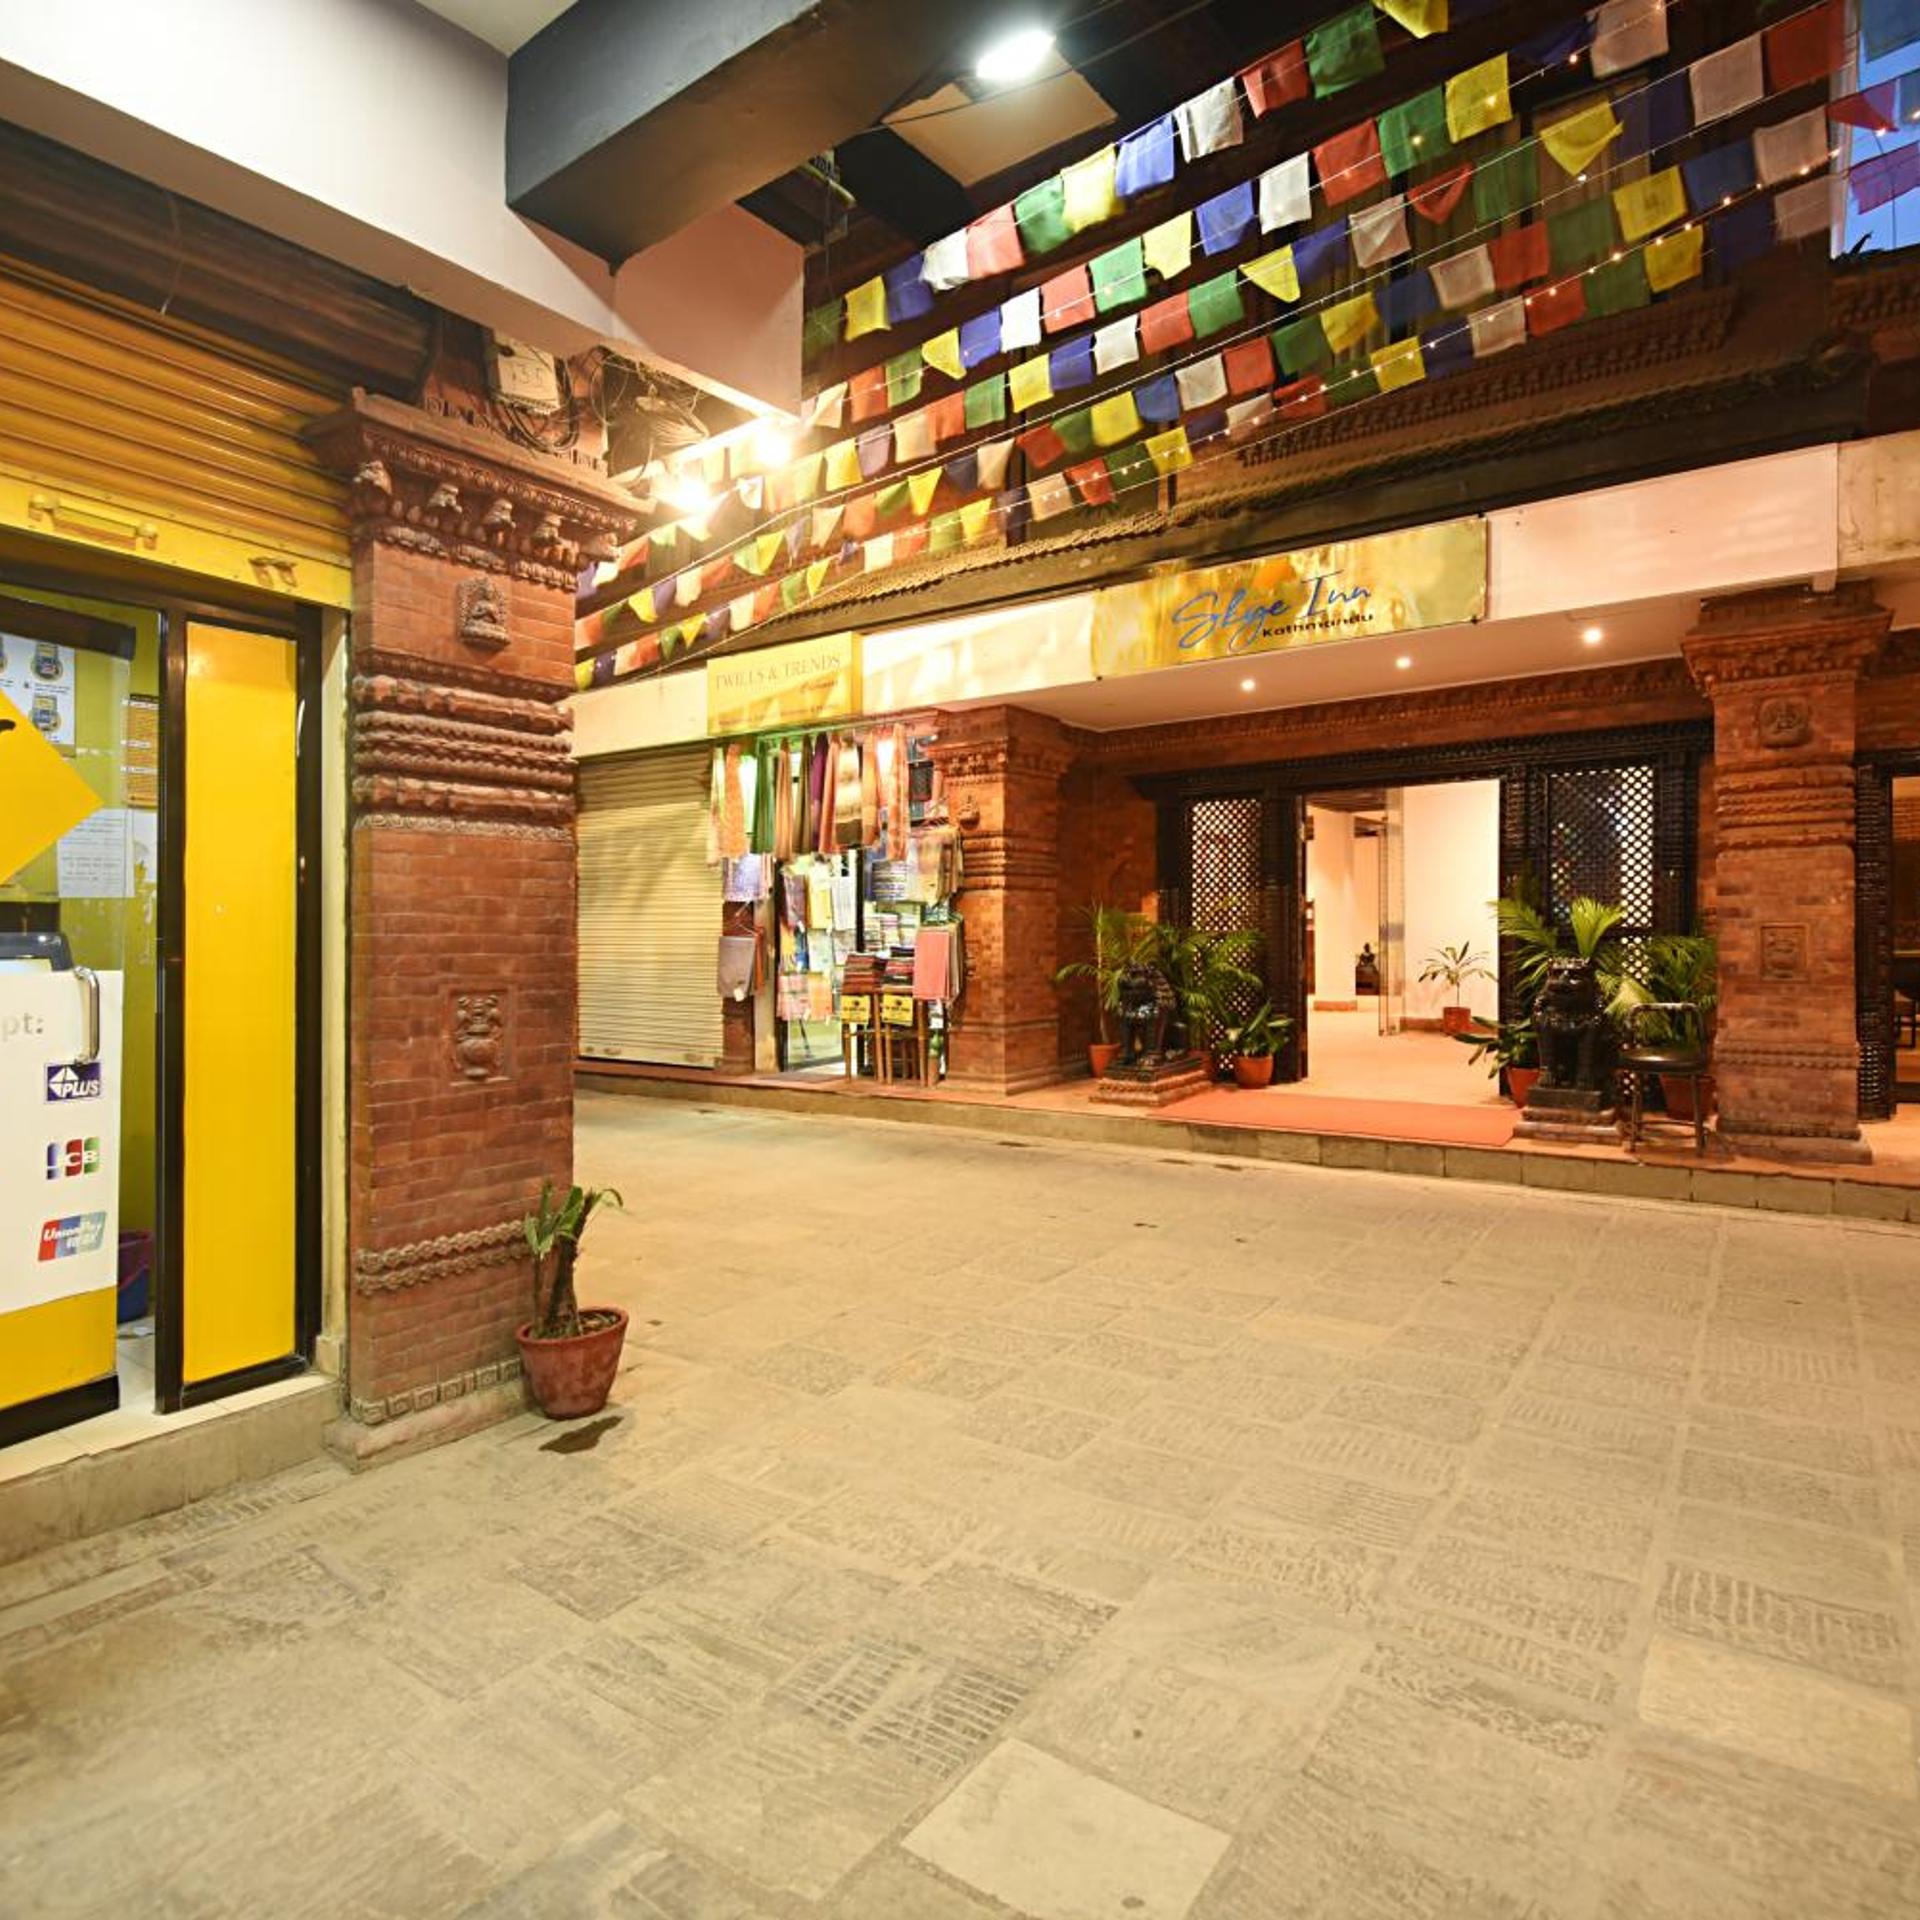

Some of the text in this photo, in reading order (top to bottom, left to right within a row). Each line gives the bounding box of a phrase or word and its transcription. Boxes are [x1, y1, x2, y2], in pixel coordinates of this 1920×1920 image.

[1297, 569, 1371, 619] Inn
[1263, 614, 1373, 638] Kathmandu
[768, 664, 777, 681] &
[784, 653, 840, 679] TRENDS
[62, 1079, 100, 1098] PLUS
